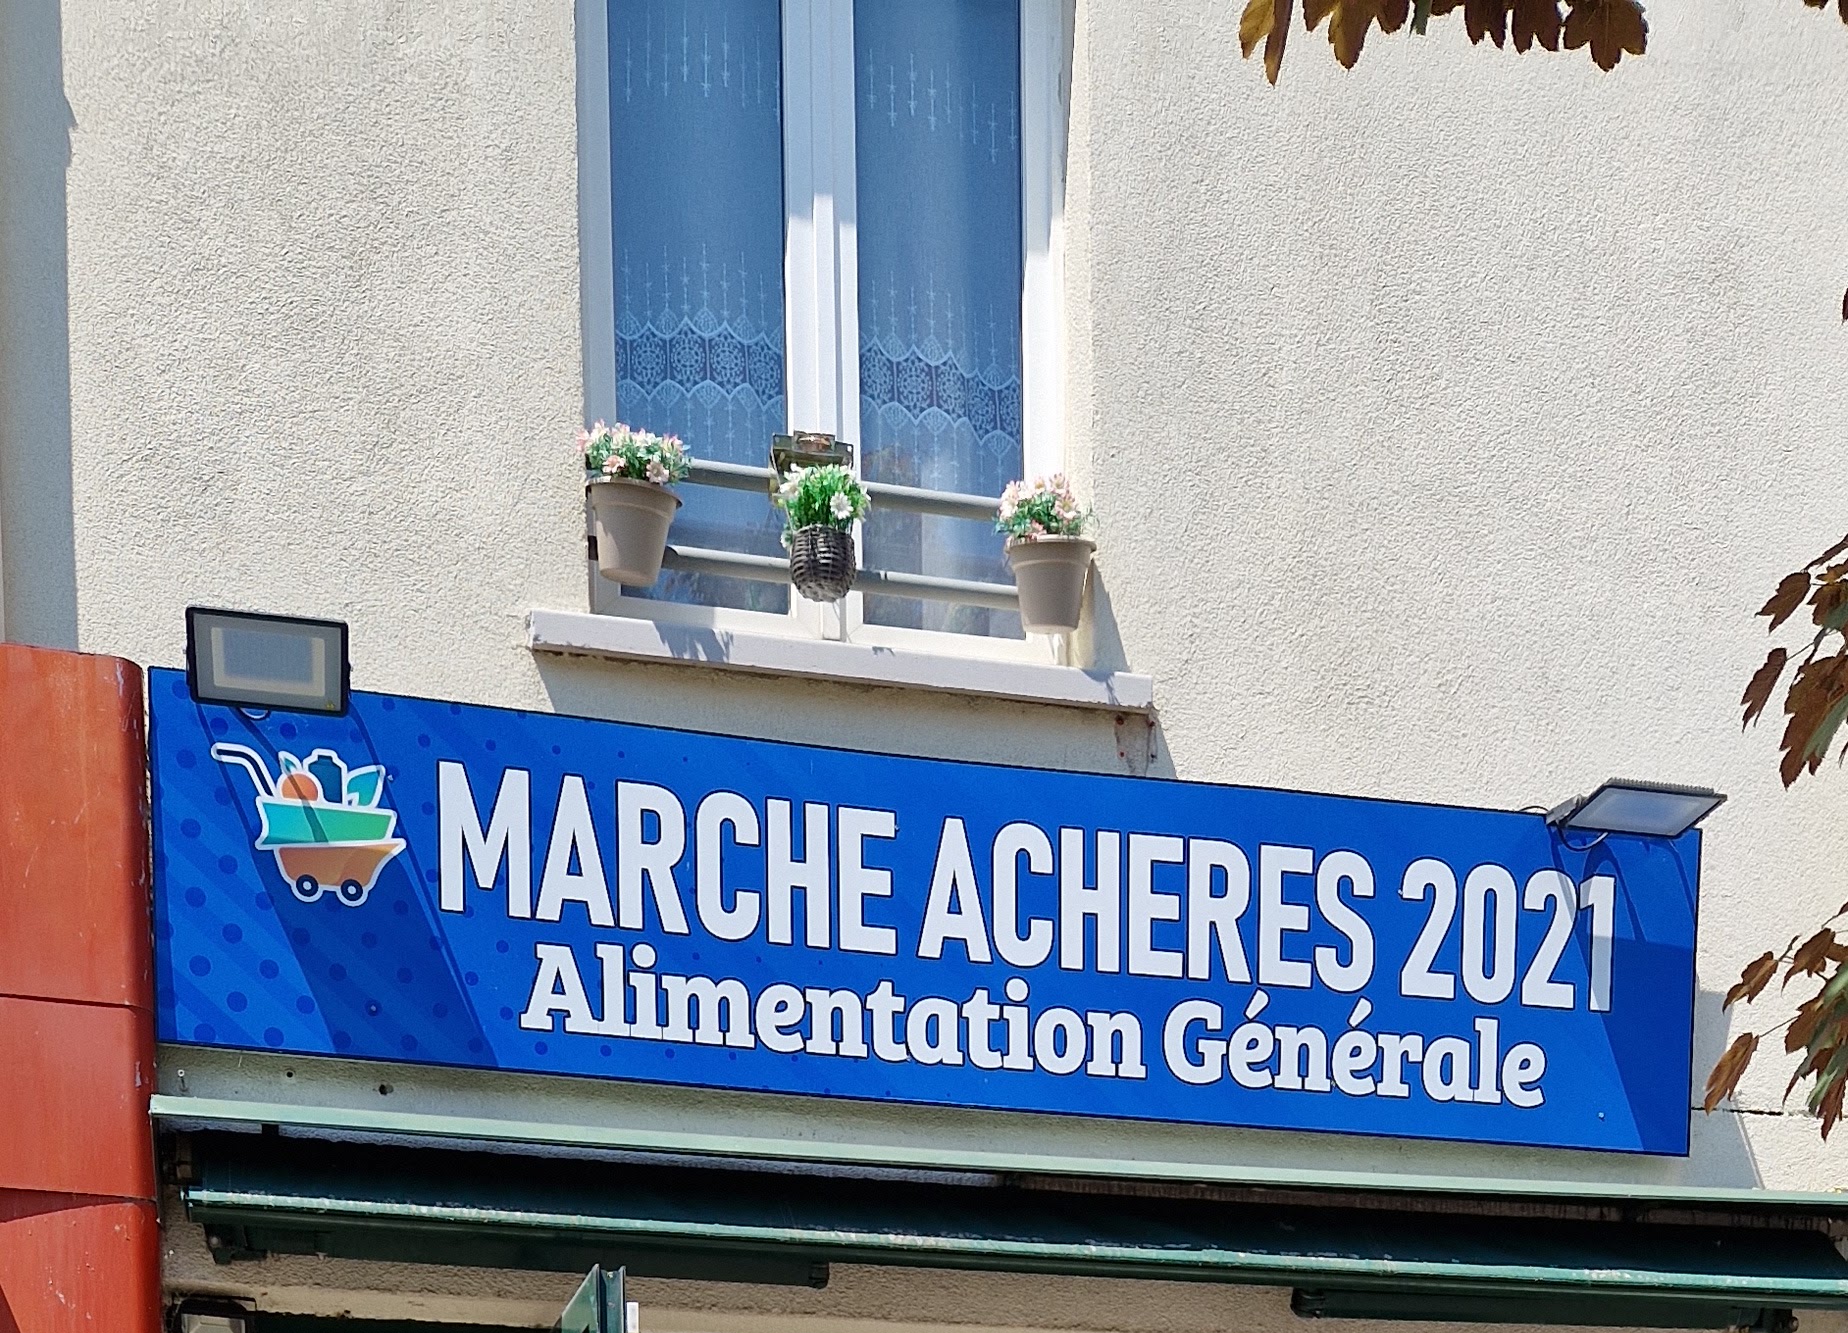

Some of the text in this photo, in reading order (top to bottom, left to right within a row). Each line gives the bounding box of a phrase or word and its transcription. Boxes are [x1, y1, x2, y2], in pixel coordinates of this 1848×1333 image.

[437, 760, 1616, 1013] MARCHE ACHERES 2021
[520, 941, 1547, 1109] Alimentation Générale
